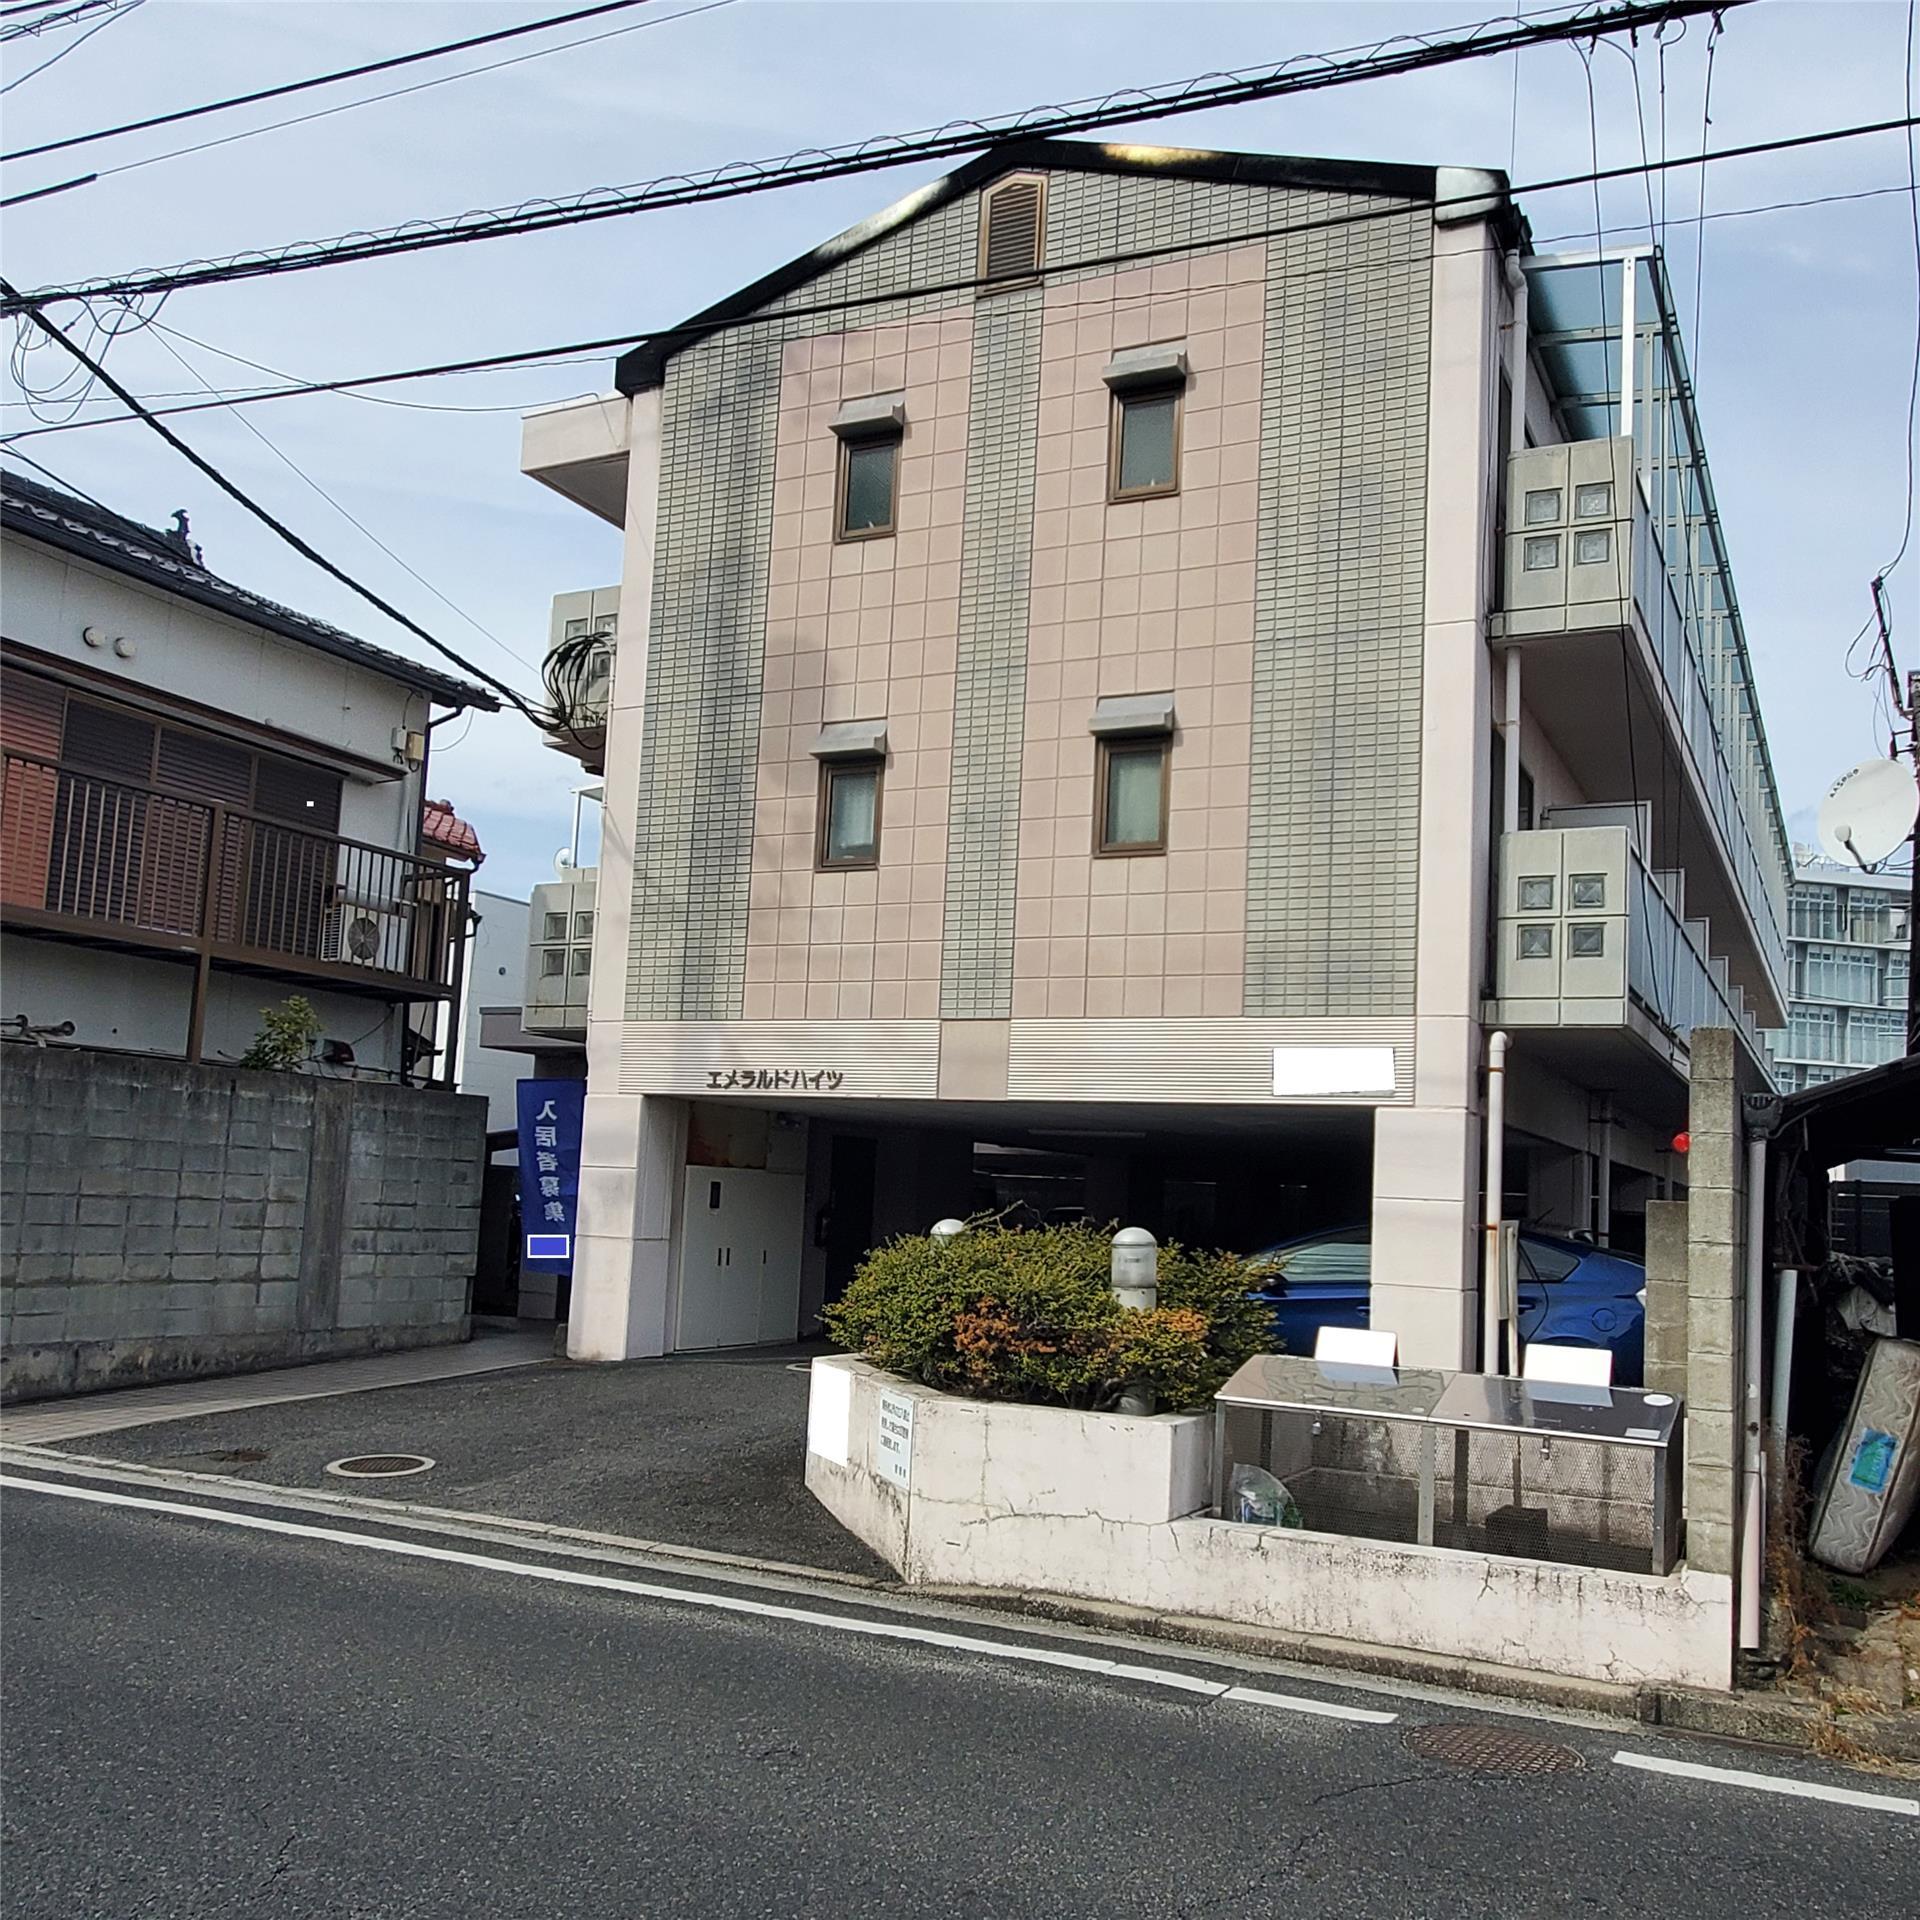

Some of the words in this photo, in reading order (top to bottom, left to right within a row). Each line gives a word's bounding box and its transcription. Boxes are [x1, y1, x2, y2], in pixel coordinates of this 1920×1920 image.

[706, 1069, 843, 1090] エメラルドハイツ
